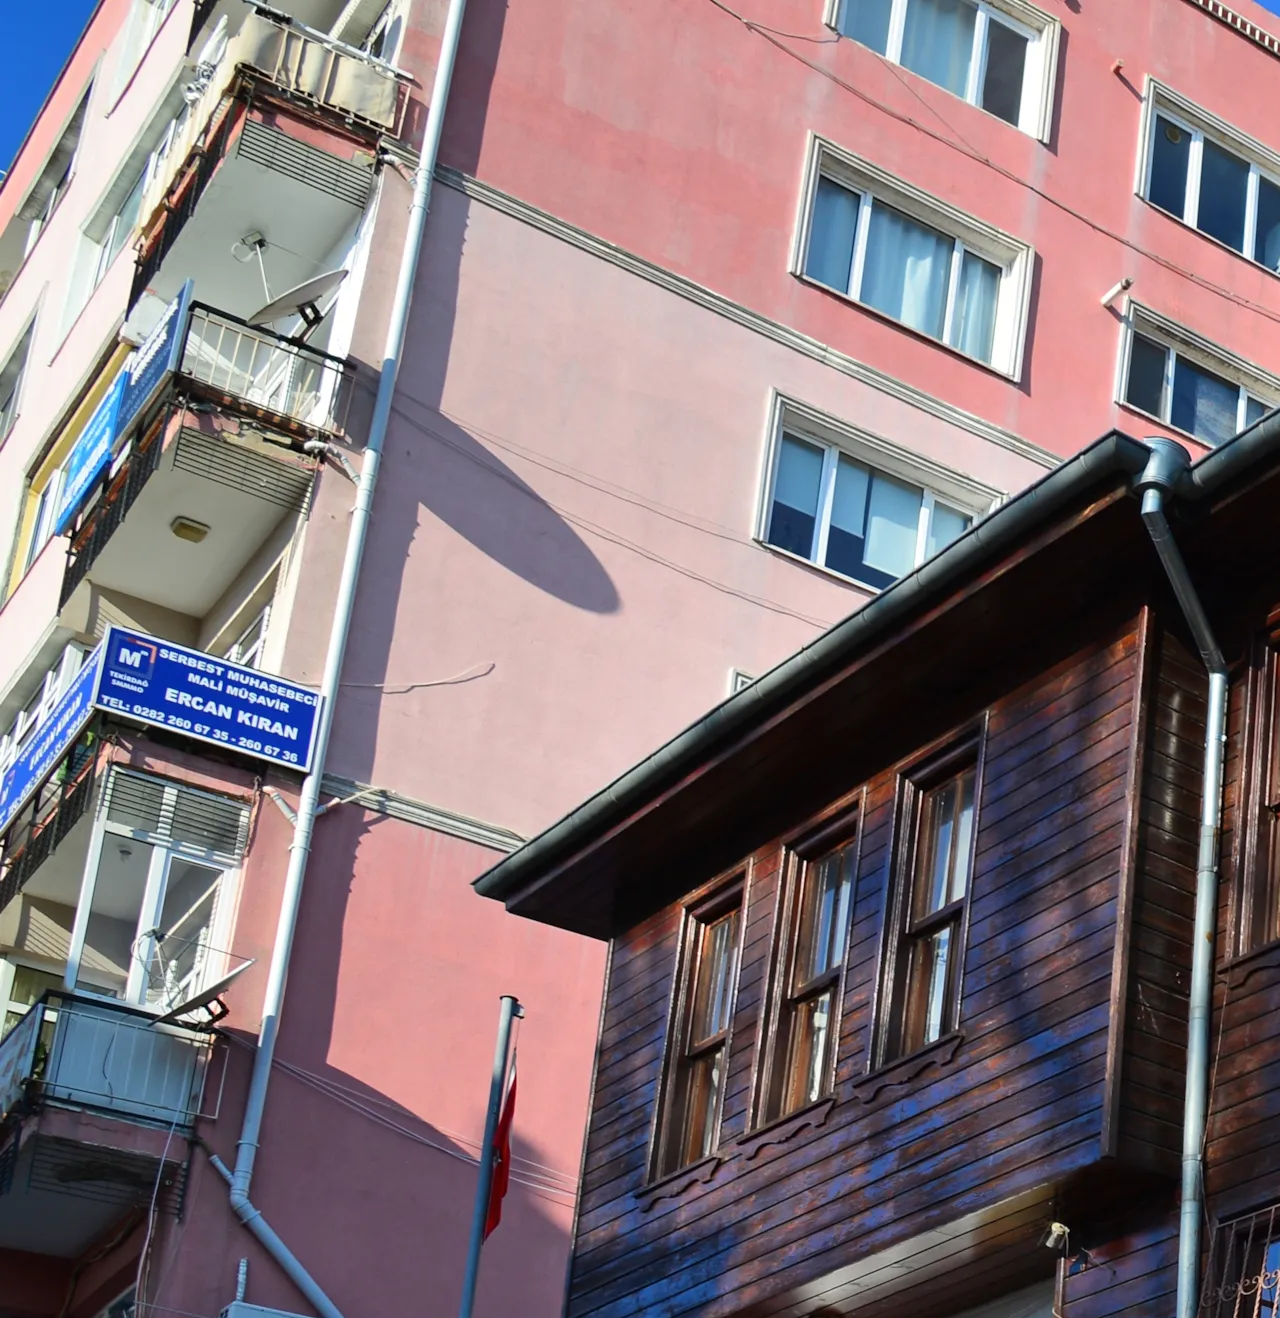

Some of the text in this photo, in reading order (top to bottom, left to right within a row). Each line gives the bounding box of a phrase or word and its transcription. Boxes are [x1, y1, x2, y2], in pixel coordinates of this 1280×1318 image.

[159, 648, 319, 707] SERBEST MUHASEBECİ
[187, 672, 290, 713] MALİ MÜŞAVİR
[101, 694, 131, 711] TEL:
[133, 704, 166, 722] 0282
[167, 714, 192, 730] 260
[194, 723, 211, 735] 67
[212, 729, 229, 741] 35
[238, 737, 262, 752] 260
[263, 744, 280, 757] 67
[282, 750, 298, 763] 36
[164, 687, 299, 741] ERCAN KIRAN
